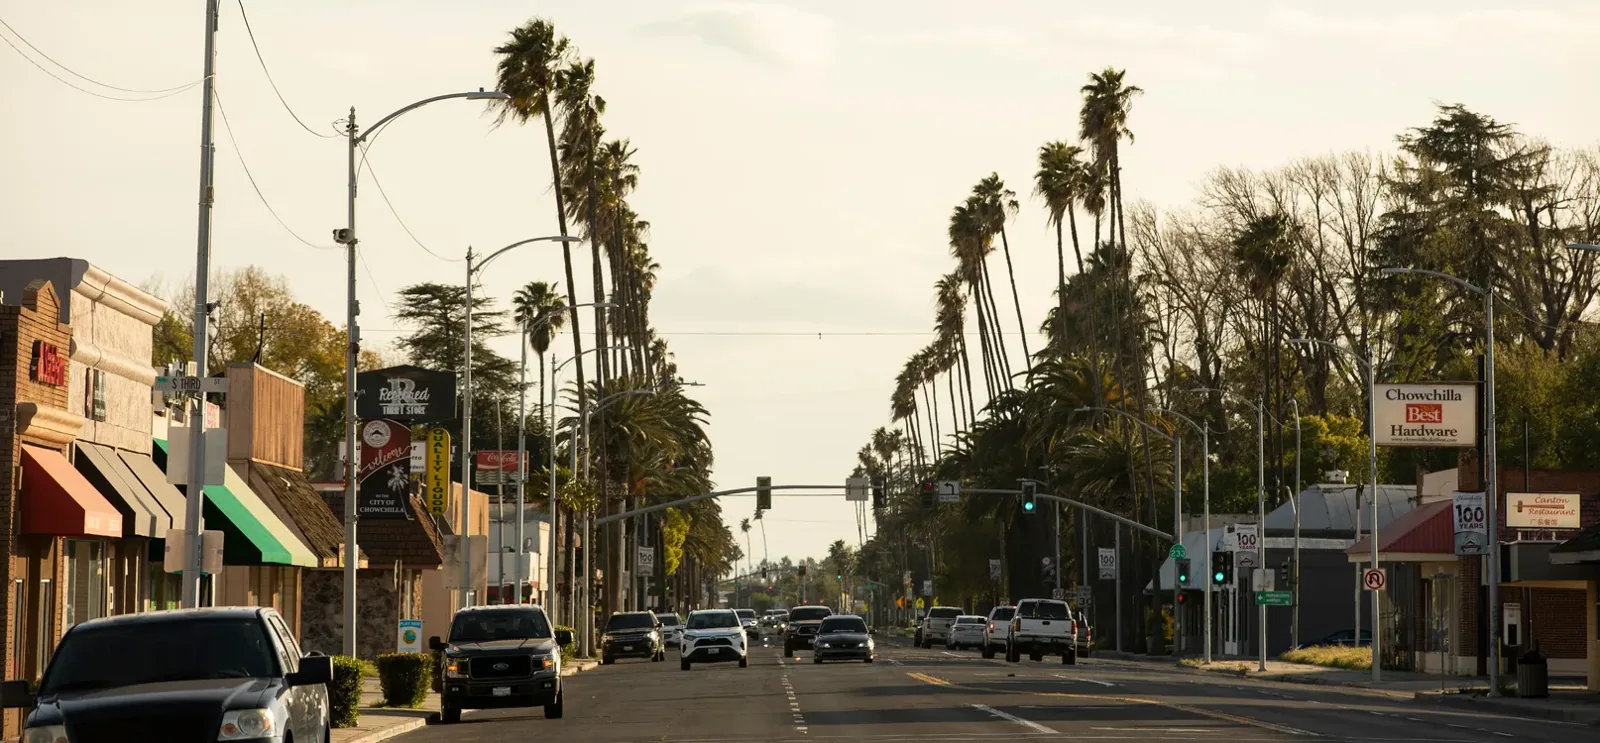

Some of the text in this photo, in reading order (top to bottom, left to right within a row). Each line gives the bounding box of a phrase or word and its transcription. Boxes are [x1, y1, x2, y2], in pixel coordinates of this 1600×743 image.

[172, 378, 178, 389] S
[181, 378, 201, 390] THIRD
[1386, 388, 1462, 401] Chowchilla
[383, 406, 426, 415] THRIFT STORE
[1408, 406, 1440, 422] Best
[1391, 424, 1458, 437] Hardware
[363, 446, 410, 472] welcome
[487, 453, 517, 462] CocaCola
[432, 429, 444, 512] QUALITY LIQUOR
[1455, 505, 1484, 522] 100
[1528, 508, 1576, 516] Restaurant
[1237, 533, 1256, 545] 100
[1100, 554, 1114, 564] 100
[1079, 597, 1092, 605] 30
